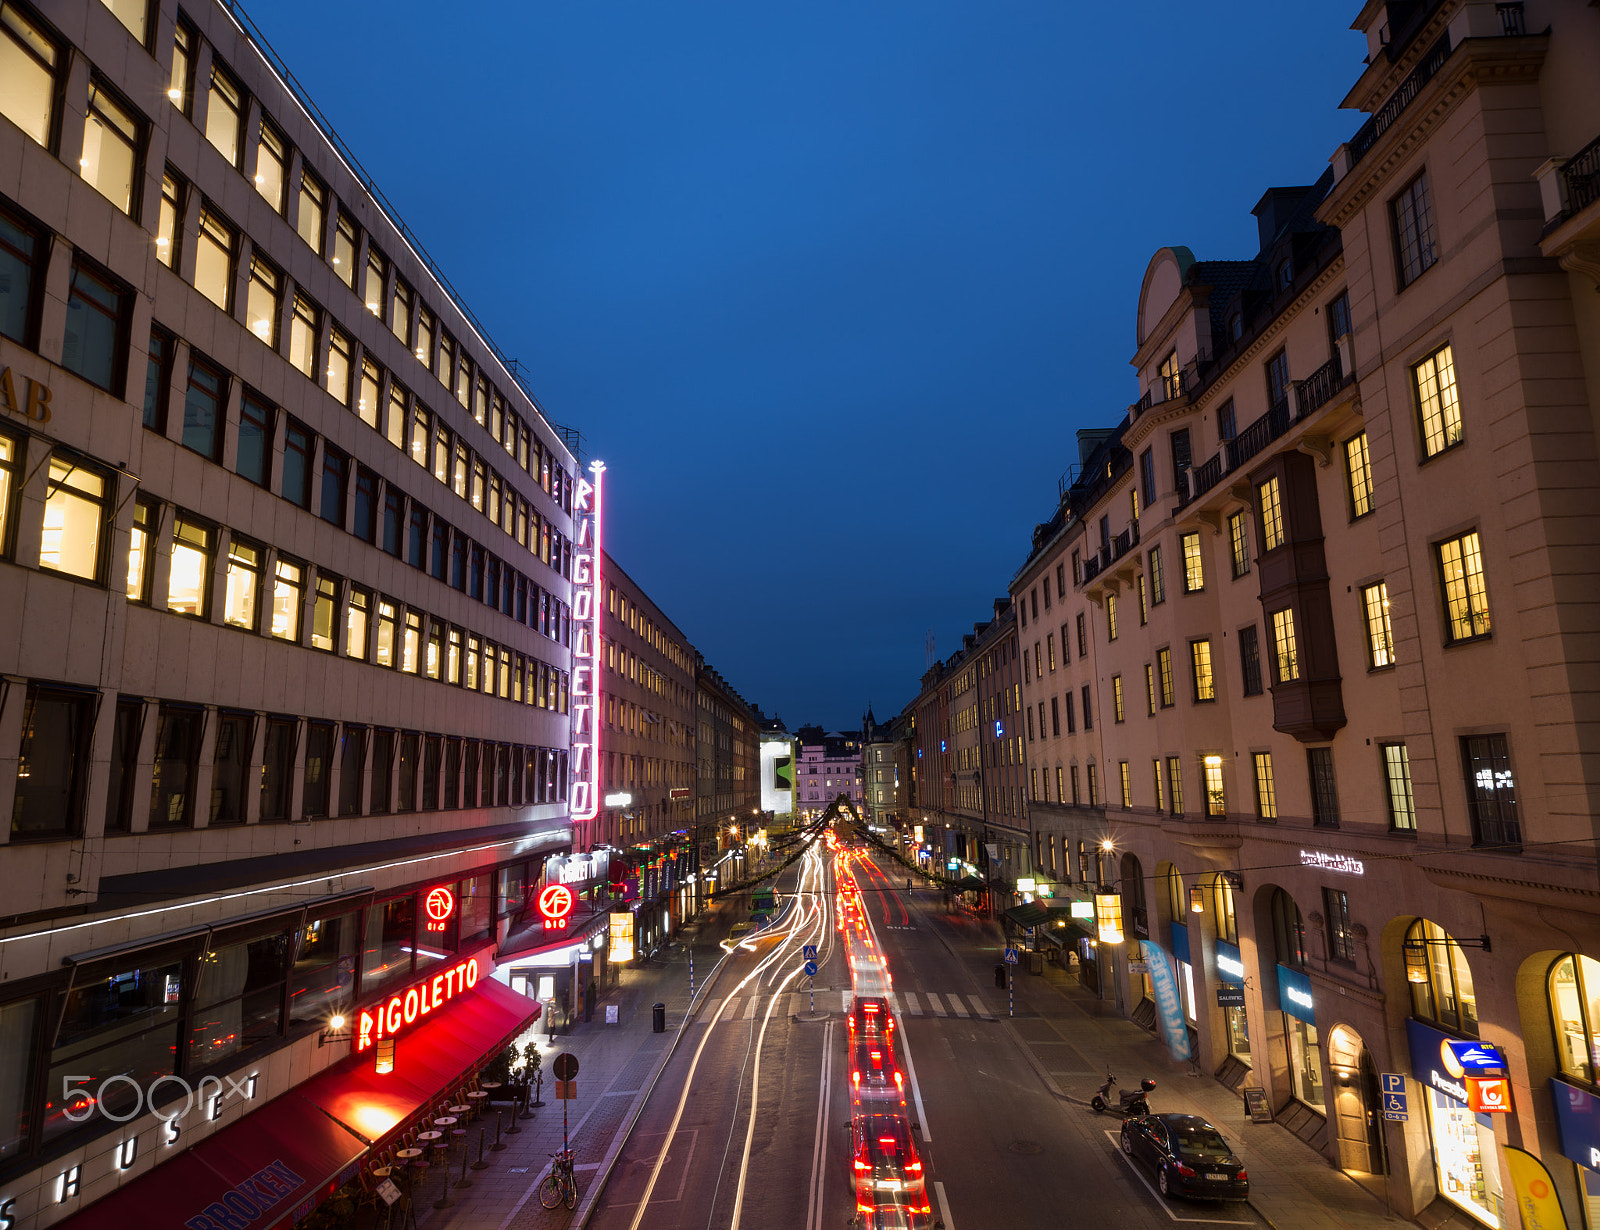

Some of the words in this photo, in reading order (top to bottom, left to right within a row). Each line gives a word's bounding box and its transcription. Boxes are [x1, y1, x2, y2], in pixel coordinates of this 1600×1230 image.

[0, 366, 53, 423] AB
[571, 478, 593, 814] RIGOLETTO
[545, 919, 566, 929] BIO
[358, 958, 478, 1051] RIGOLETTO
[1389, 1076, 1400, 1091] P
